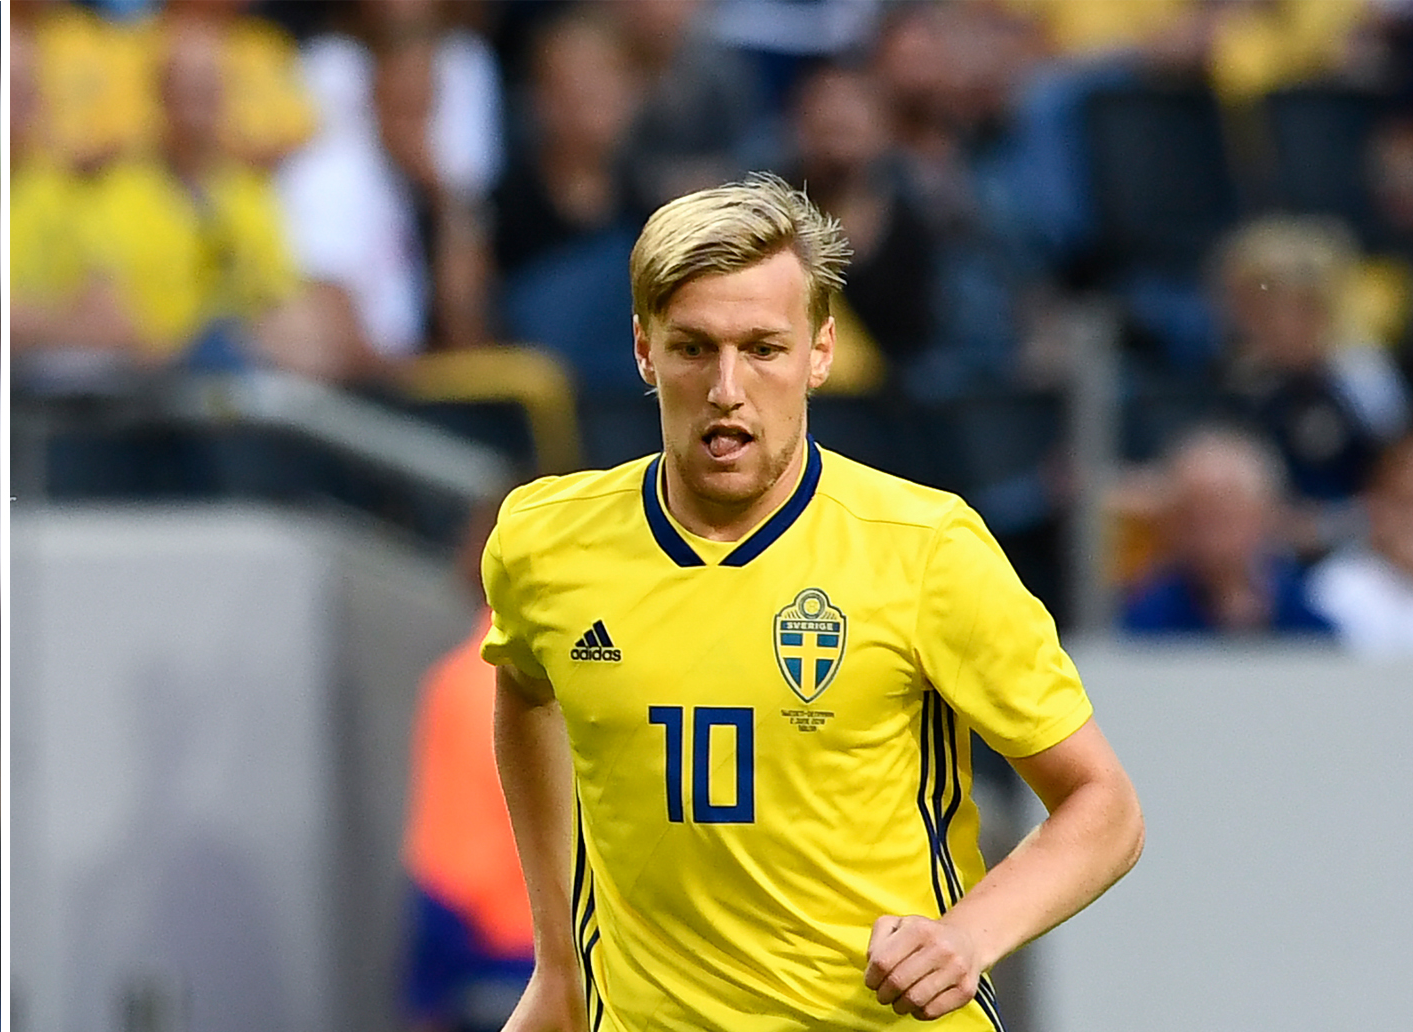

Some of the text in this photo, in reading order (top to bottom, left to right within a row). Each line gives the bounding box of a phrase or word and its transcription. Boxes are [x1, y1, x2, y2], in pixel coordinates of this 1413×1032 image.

[786, 621, 834, 631] SVERIGE
[570, 646, 622, 662] adidas
[648, 705, 755, 824] 10
